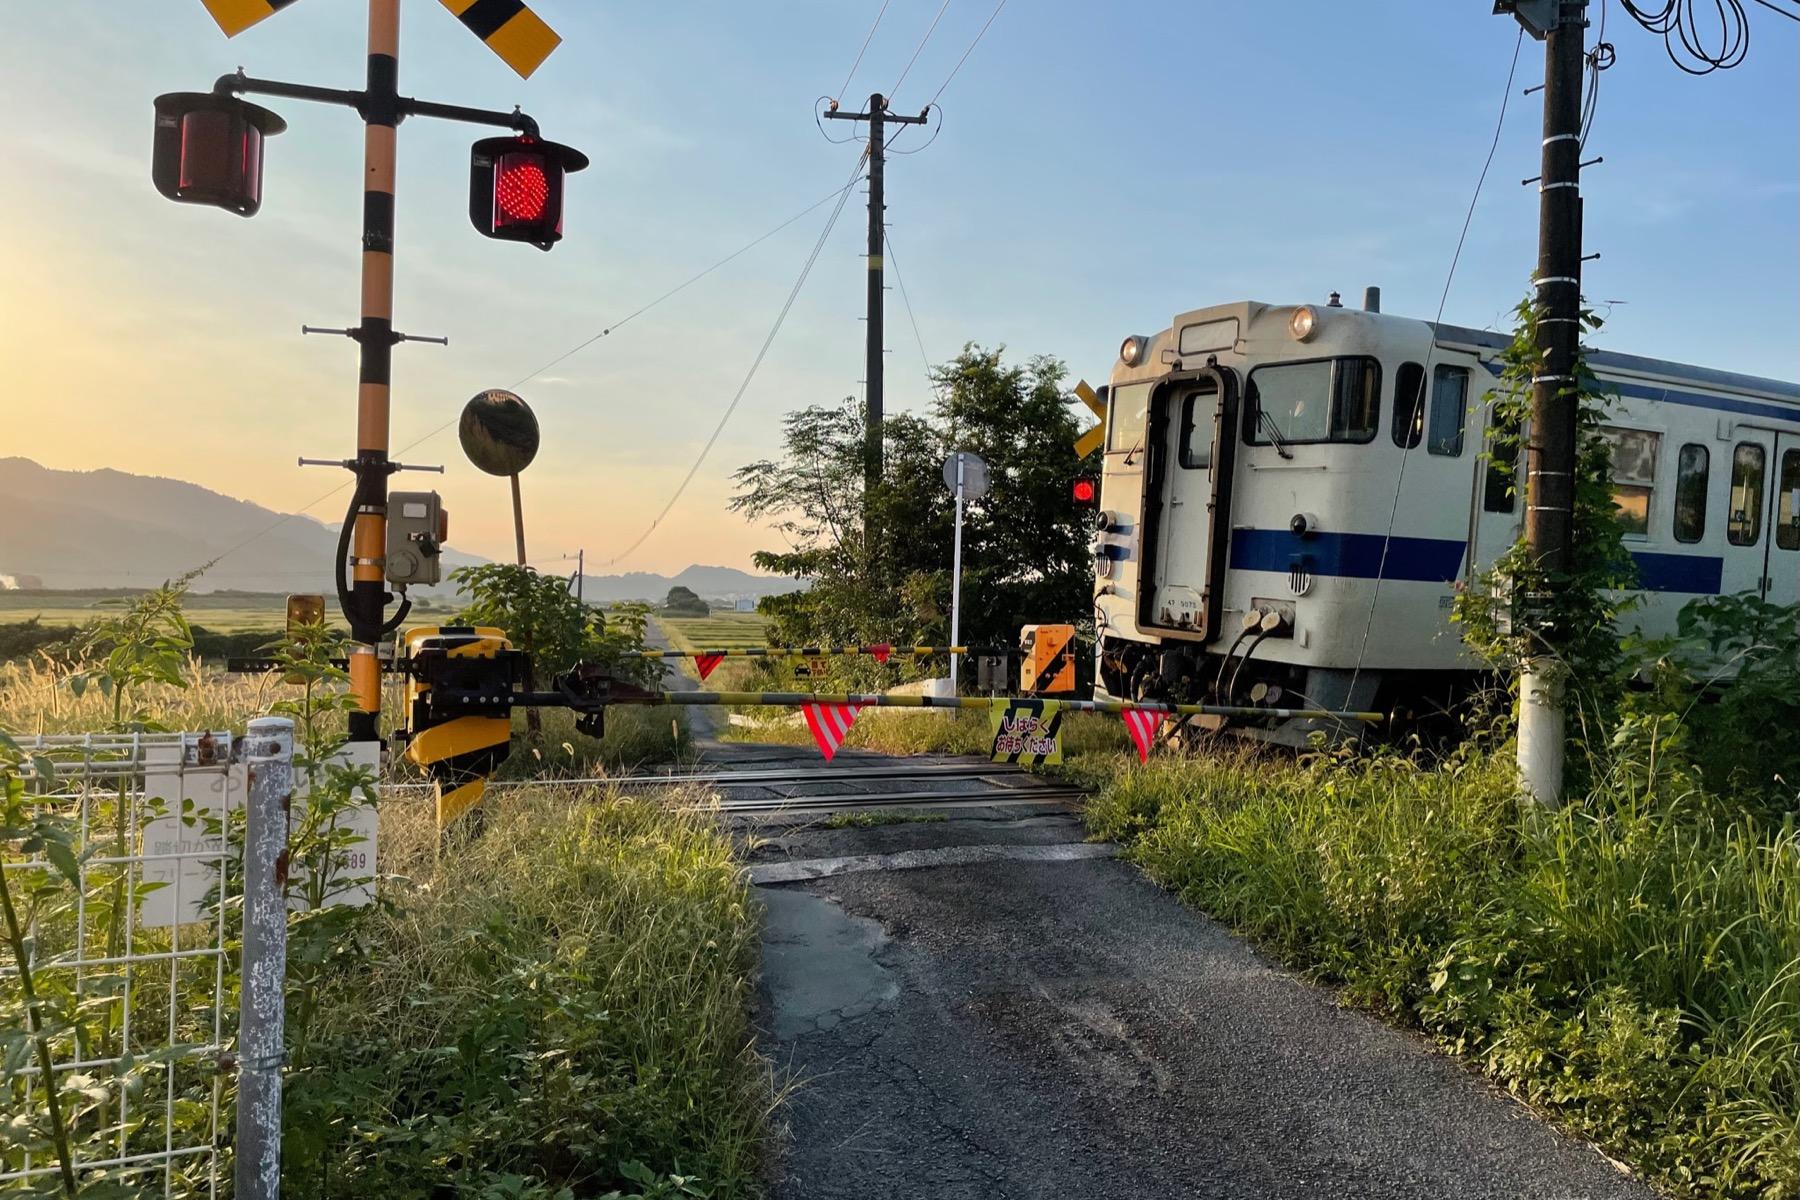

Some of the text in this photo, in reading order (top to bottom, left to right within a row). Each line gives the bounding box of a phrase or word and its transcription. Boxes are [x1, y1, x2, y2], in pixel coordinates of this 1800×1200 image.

[1003, 716, 1050, 734] しばらく
[996, 736, 1057, 754] お待ちください
